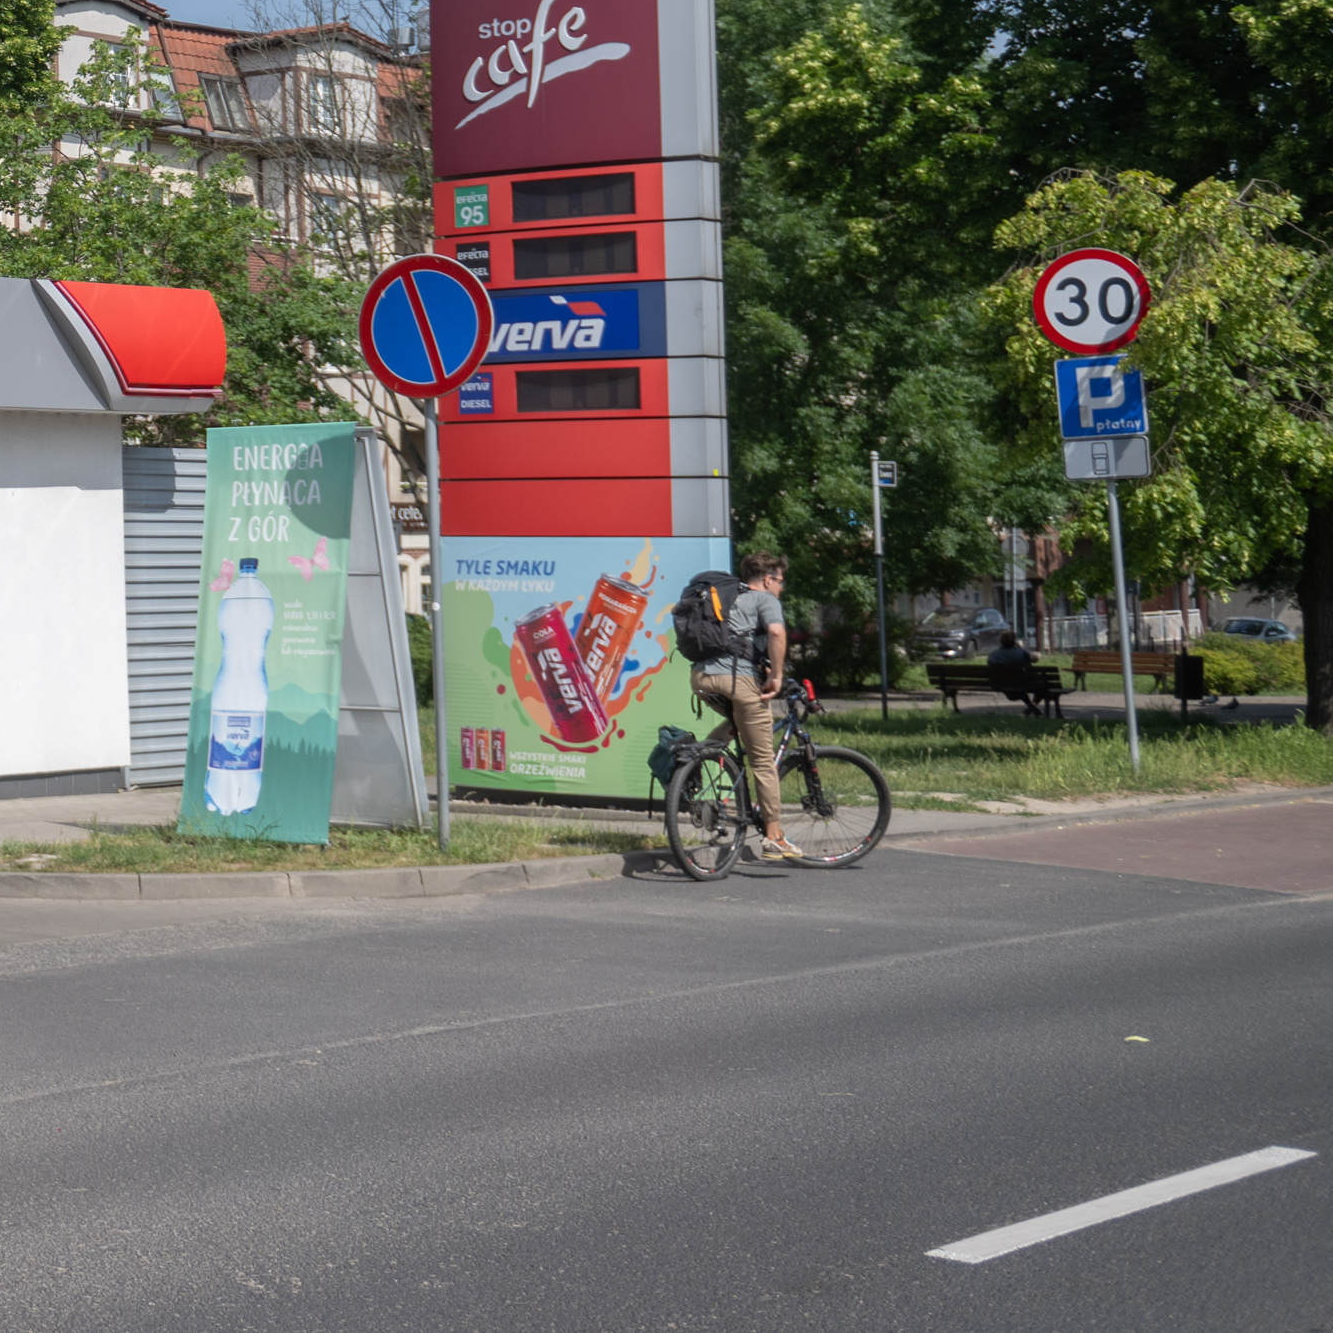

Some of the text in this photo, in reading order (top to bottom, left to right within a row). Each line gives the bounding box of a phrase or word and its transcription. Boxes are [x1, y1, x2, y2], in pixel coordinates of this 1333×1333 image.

[477, 15, 531, 40] stop
[460, 205, 485, 226] 95
[1053, 276, 1134, 327] 30
[487, 318, 606, 353] verva
[461, 381, 490, 391] verva
[460, 399, 491, 409] DIESEL
[1075, 365, 1126, 428] P
[1096, 417, 1142, 433] płatny
[231, 478, 321, 511] PŁYNĄCA
[228, 510, 290, 543] Z GÓR
[456, 559, 556, 576] TYLE SMAKU
[455, 576, 556, 592] W KAŻDYM ŁYKU
[283, 598, 303, 608] woda
[532, 625, 554, 640] COLA
[584, 614, 618, 684] verva
[543, 647, 583, 715] verva
[509, 751, 587, 764] WSZYSTKIE SMAKI
[510, 762, 586, 778] ORZEŹWIENIA
